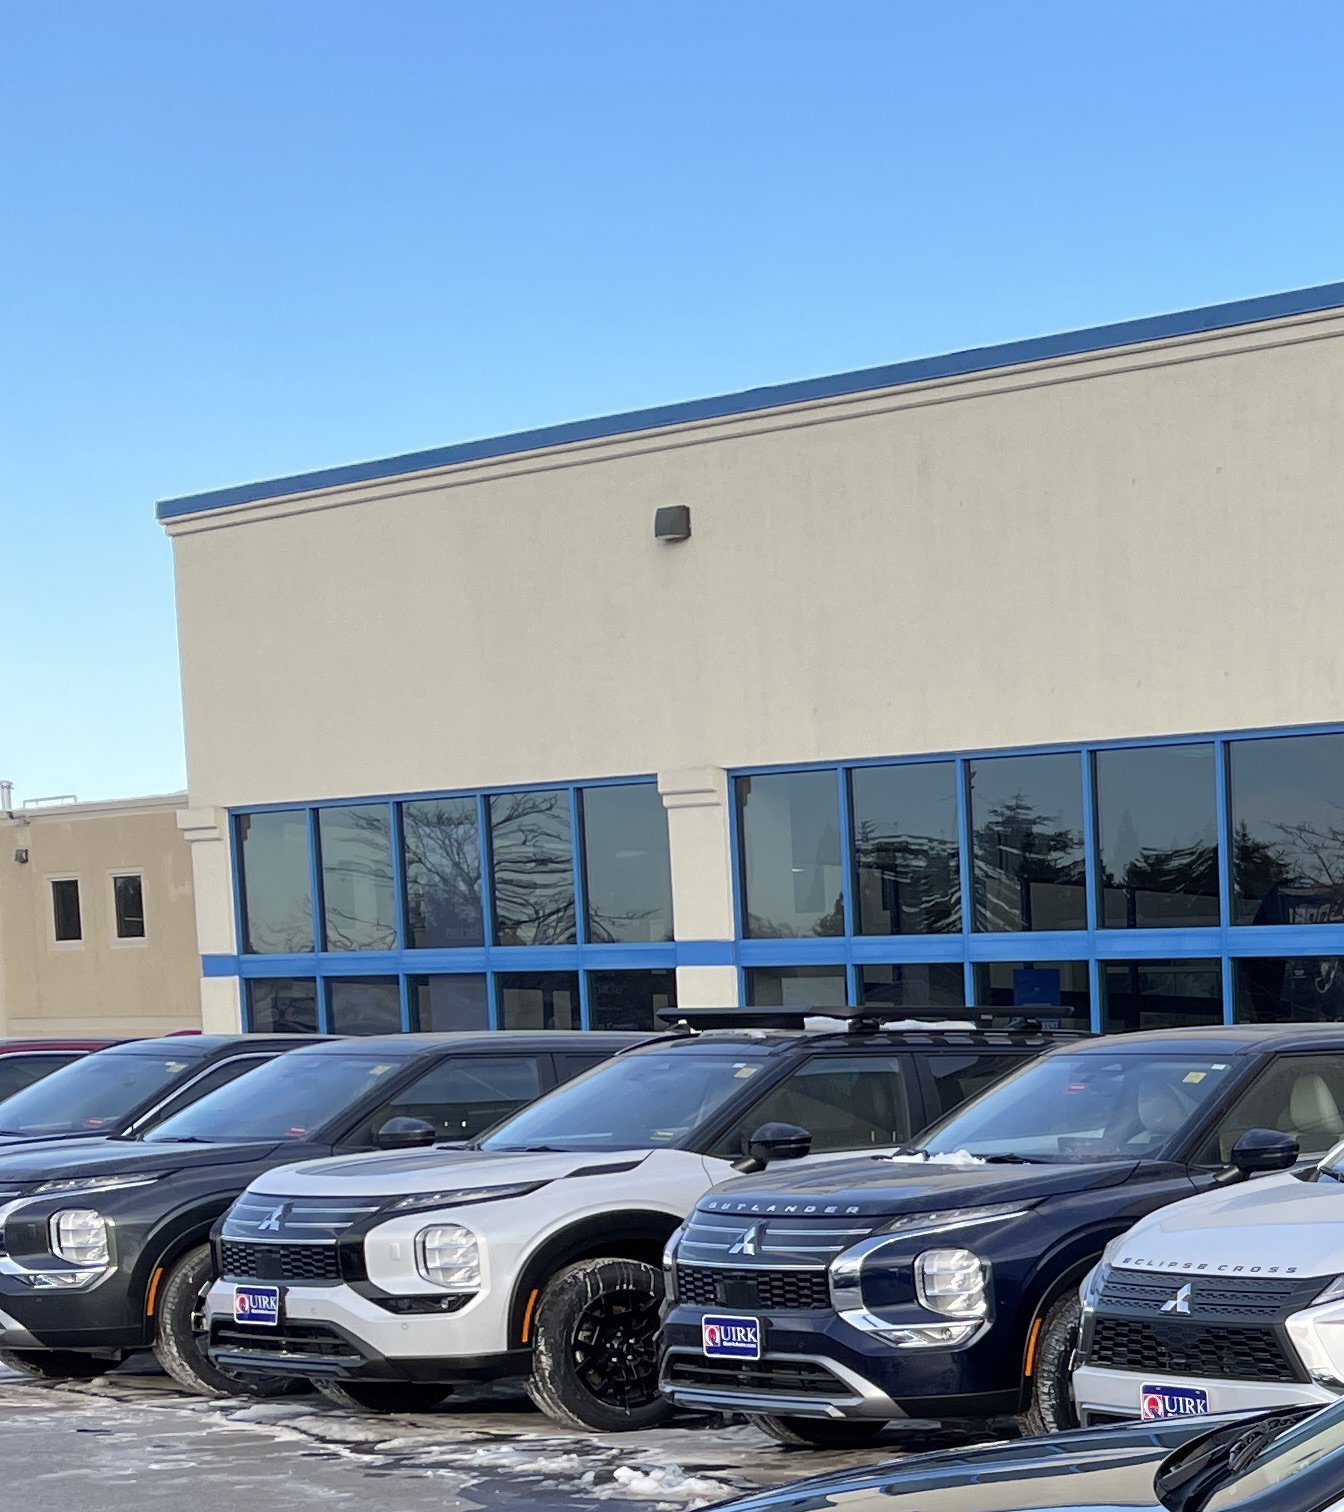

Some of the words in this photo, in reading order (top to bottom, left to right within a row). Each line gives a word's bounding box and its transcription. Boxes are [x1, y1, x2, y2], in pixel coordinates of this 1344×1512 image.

[708, 1202, 860, 1214] OUTLANDER
[1122, 1257, 1209, 1270] ECLIPSE
[1217, 1264, 1298, 1274] CROSS
[236, 1294, 277, 1313] QUIRK
[705, 1325, 758, 1346] QUIRK
[1143, 1394, 1206, 1418] QUIRK
